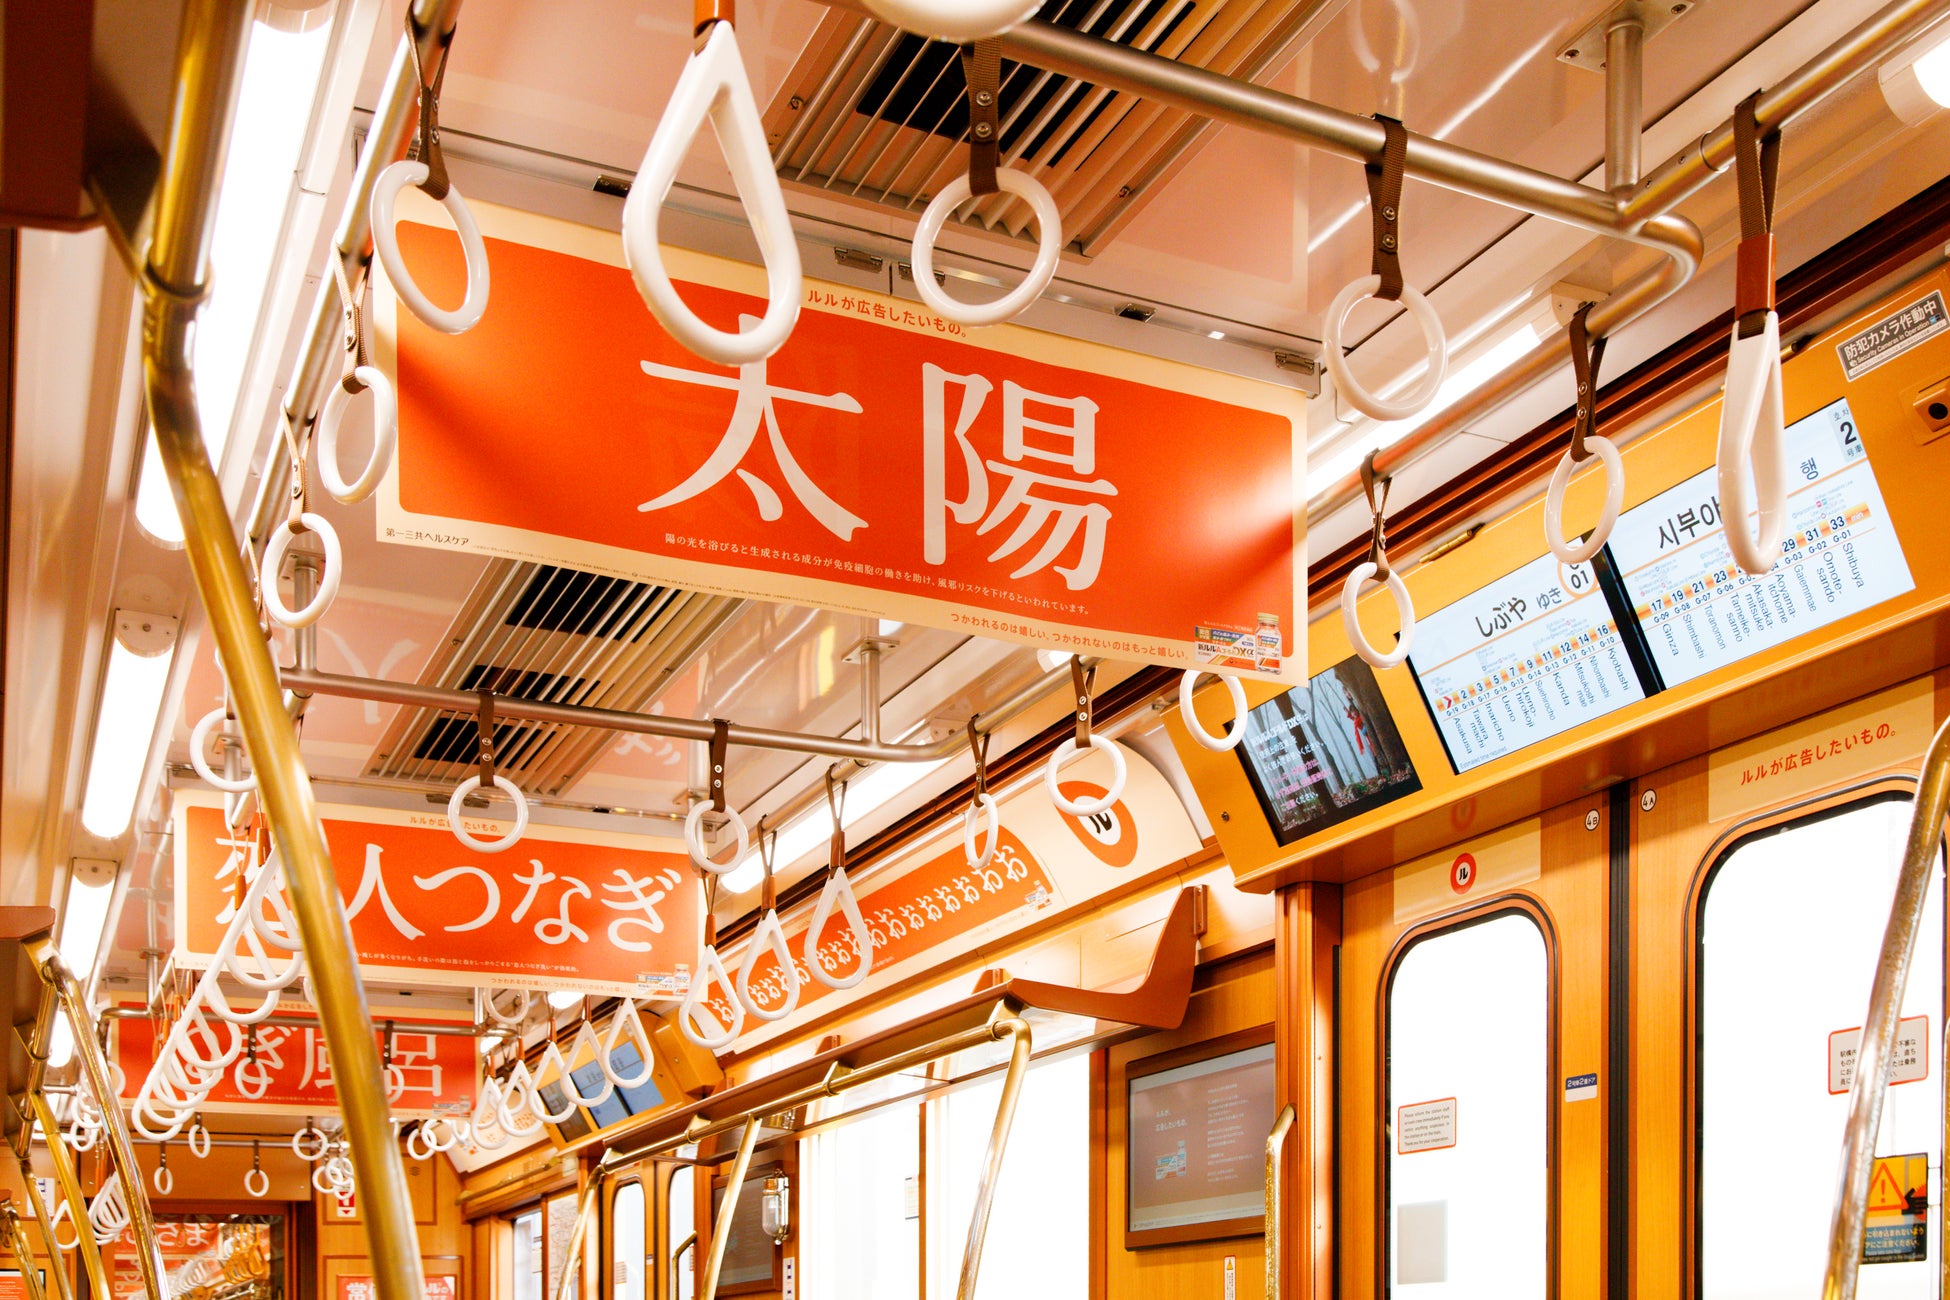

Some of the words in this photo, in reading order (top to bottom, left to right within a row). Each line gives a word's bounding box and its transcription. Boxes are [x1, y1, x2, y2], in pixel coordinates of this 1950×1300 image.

[808, 290, 966, 338] ルルが広告したいもの。
[1843, 300, 1937, 361] 防犯カメラ作動中
[1877, 337, 1899, 352] Cameras
[1904, 321, 1930, 338] Operation
[637, 313, 1119, 591] 太陽
[1840, 421, 1857, 445] 2
[1800, 457, 1819, 480] 행
[386, 528, 470, 546] 第一三共ヘルスケア
[1570, 569, 1589, 589] 01
[1651, 599, 1662, 611] 17
[1672, 590, 1684, 601] 19
[1692, 580, 1704, 593] 21
[1713, 570, 1727, 583] 23
[1782, 538, 1796, 552] 29
[1805, 528, 1819, 542] 31
[1830, 516, 1845, 530] 33
[1654, 612, 1669, 623] G-09
[1674, 602, 1690, 614] G-08
[1695, 593, 1711, 604] G-07
[1717, 584, 1733, 595] G-06
[1784, 551, 1803, 564] G-03
[1808, 540, 1827, 553] G-02
[1833, 530, 1851, 543] G-01
[1823, 551, 1842, 594] Omote-
[1843, 543, 1864, 588] Shibuya
[1768, 583, 1788, 624] itchome
[1775, 573, 1796, 618] Aoyama-
[1794, 564, 1816, 612] Gaiemmae
[1817, 567, 1835, 603] sando
[1475, 597, 1526, 637] しぶや
[1536, 587, 1562, 610] ゆき
[1745, 593, 1764, 631] mitsuke
[1752, 583, 1773, 628] Akasaka-
[1662, 623, 1679, 656] Ginza
[1683, 614, 1705, 659] Shimbashi
[1704, 604, 1726, 650] Toranomon
[1726, 612, 1743, 642] sanno
[1461, 690, 1467, 699] 2
[1476, 682, 1483, 692] 3
[1493, 674, 1500, 684] 5
[1509, 667, 1515, 676] 7
[1526, 660, 1533, 669] 9
[1543, 651, 1553, 661] 11
[1560, 642, 1571, 653] 12
[1579, 634, 1590, 645] 14
[1597, 625, 1608, 636] 16
[1608, 647, 1630, 691] Kyobashi
[1502, 695, 1516, 722] Ueno
[1535, 680, 1556, 721] Suehirocho
[1553, 672, 1570, 706] Kanda
[1472, 708, 1489, 740] Tawara
[1485, 702, 1504, 741] Inaricho
[1516, 692, 1535, 728] hirokoji
[1453, 717, 1472, 754] Asakusa
[1741, 723, 1896, 786] ルルが広告したいもの。
[1586, 815, 1598, 826] 4B
[1642, 794, 1654, 807] 4A
[1459, 867, 1469, 880] ル
